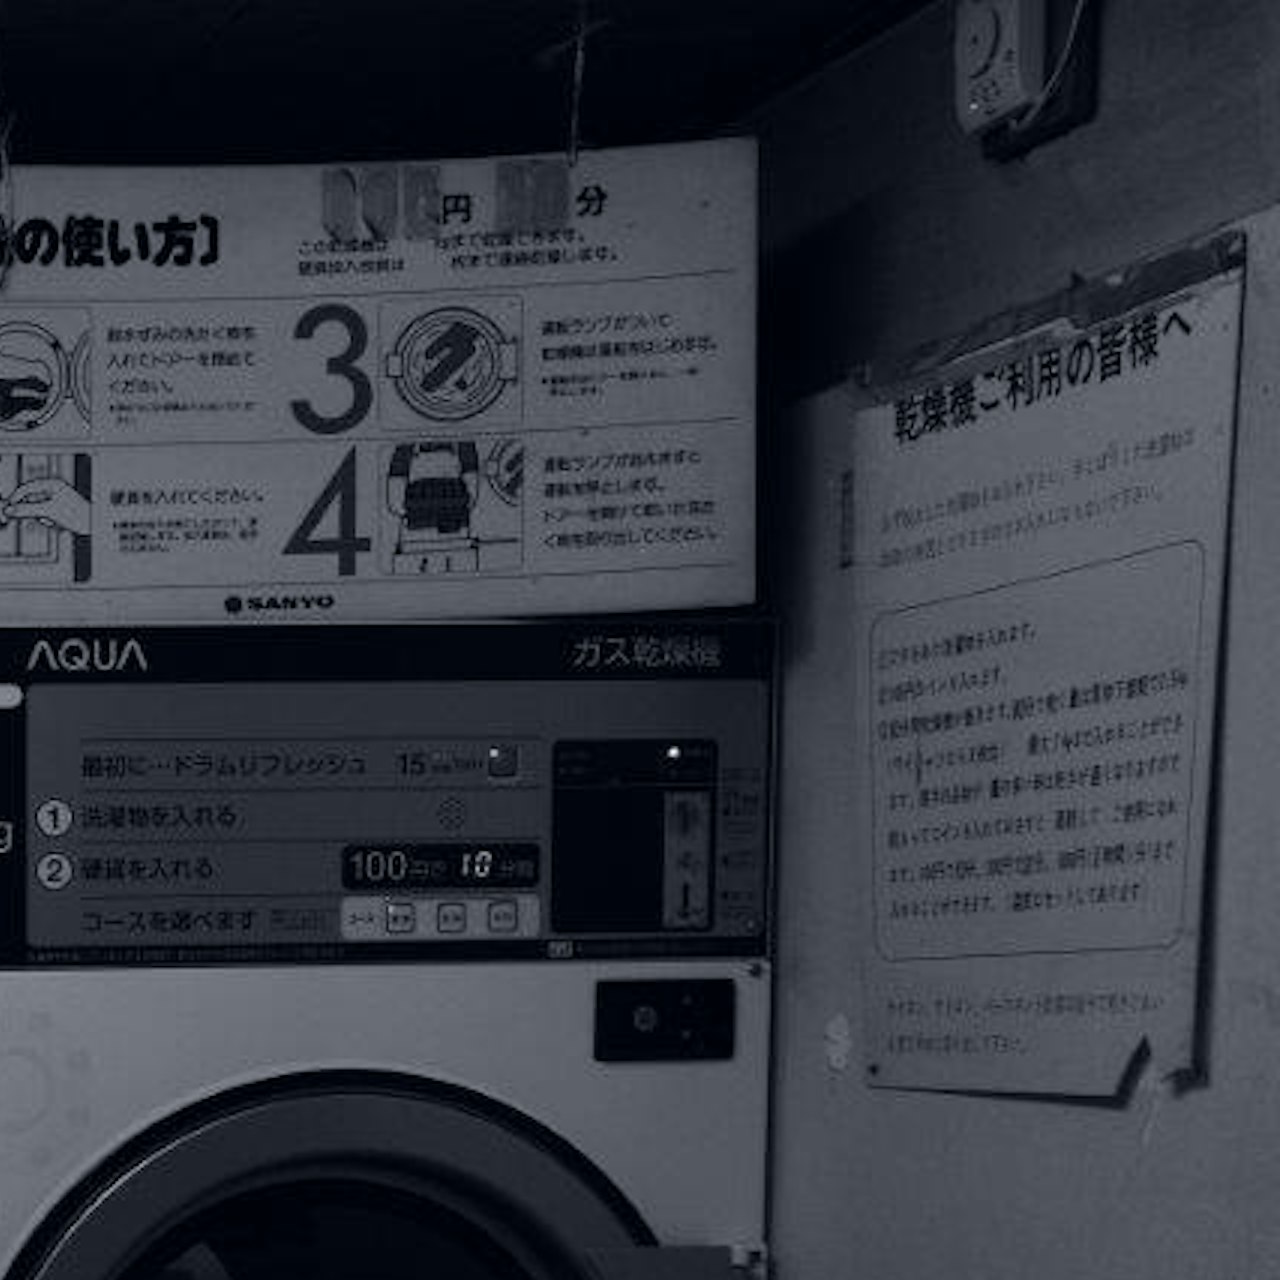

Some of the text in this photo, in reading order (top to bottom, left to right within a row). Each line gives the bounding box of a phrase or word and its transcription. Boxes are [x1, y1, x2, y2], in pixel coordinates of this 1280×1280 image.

[442, 185, 608, 225] 円 分
[291, 303, 374, 435] 3
[894, 311, 1192, 448] 乾燥機ご利用の皆様へ
[281, 444, 372, 577] 4
[247, 596, 334, 610] SANYO
[26, 636, 150, 673] AQUA
[571, 635, 724, 670] ガス乾燥機
[460, 849, 494, 879] 10
